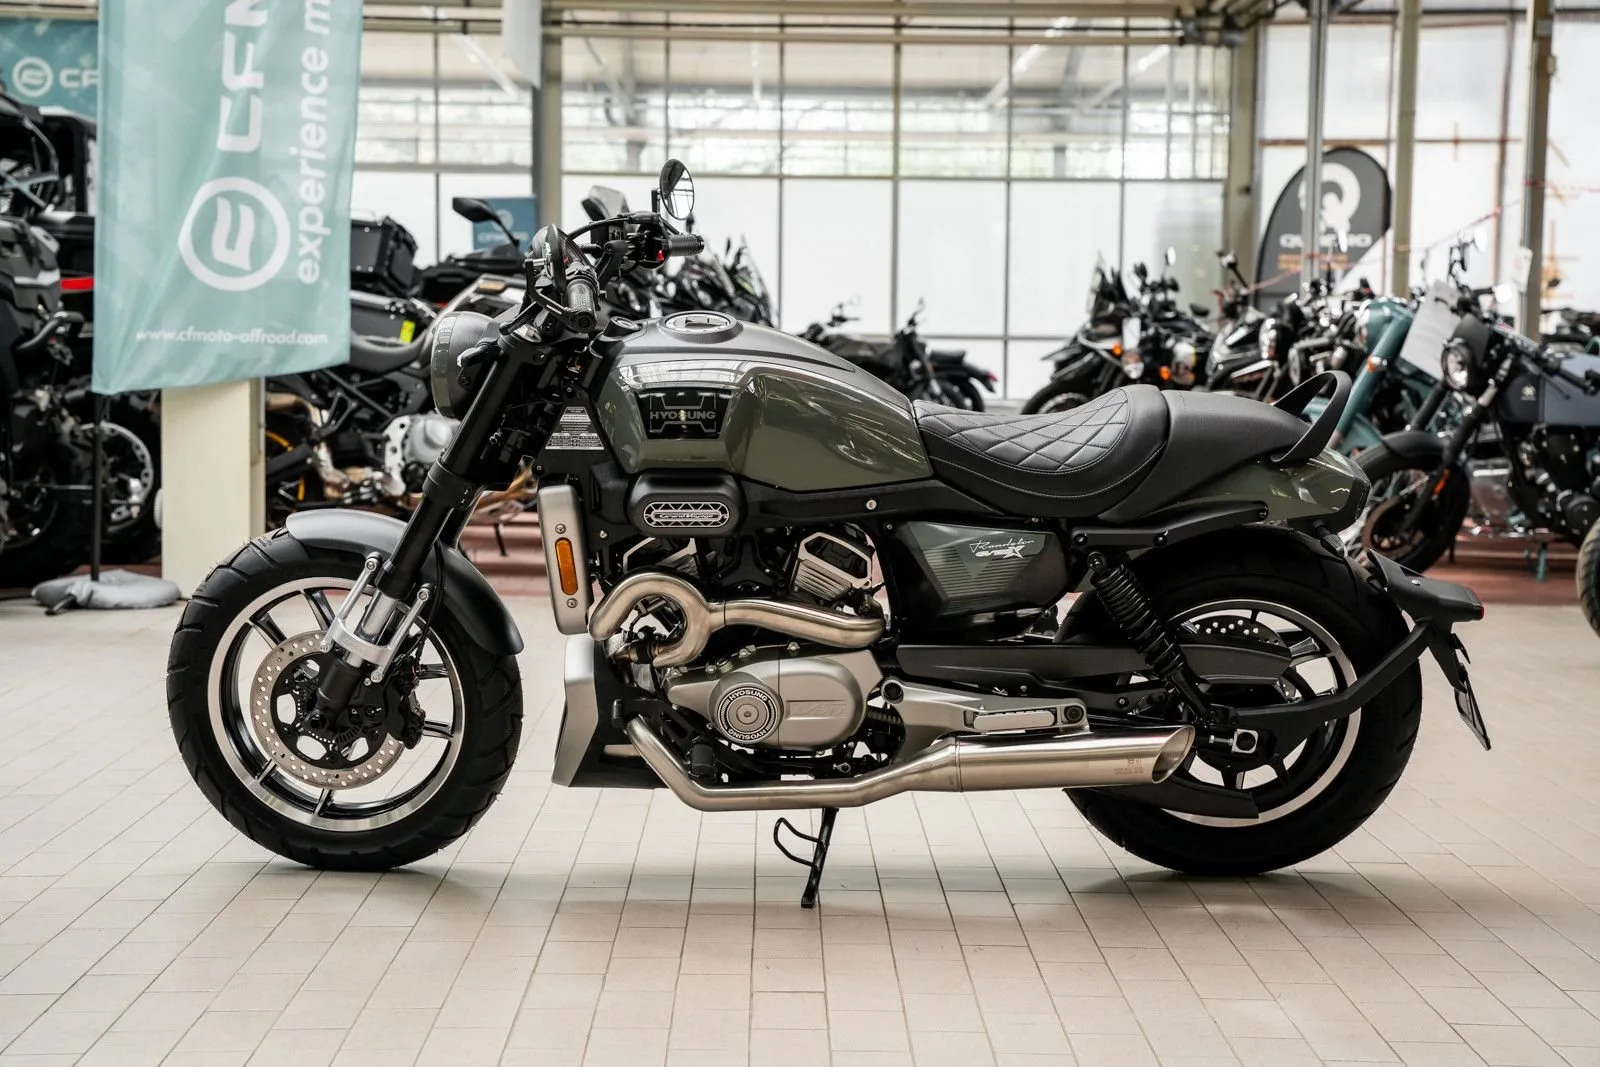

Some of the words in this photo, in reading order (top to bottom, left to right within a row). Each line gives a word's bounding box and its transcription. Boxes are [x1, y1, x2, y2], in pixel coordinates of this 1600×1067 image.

[290, 46, 332, 284] experience
[136, 326, 328, 344] www.cfmoto-offroad.com
[650, 410, 717, 420] HYOSUNG
[729, 689, 768, 701] HYOSUNG
[728, 728, 767, 740] HYOSUNG
